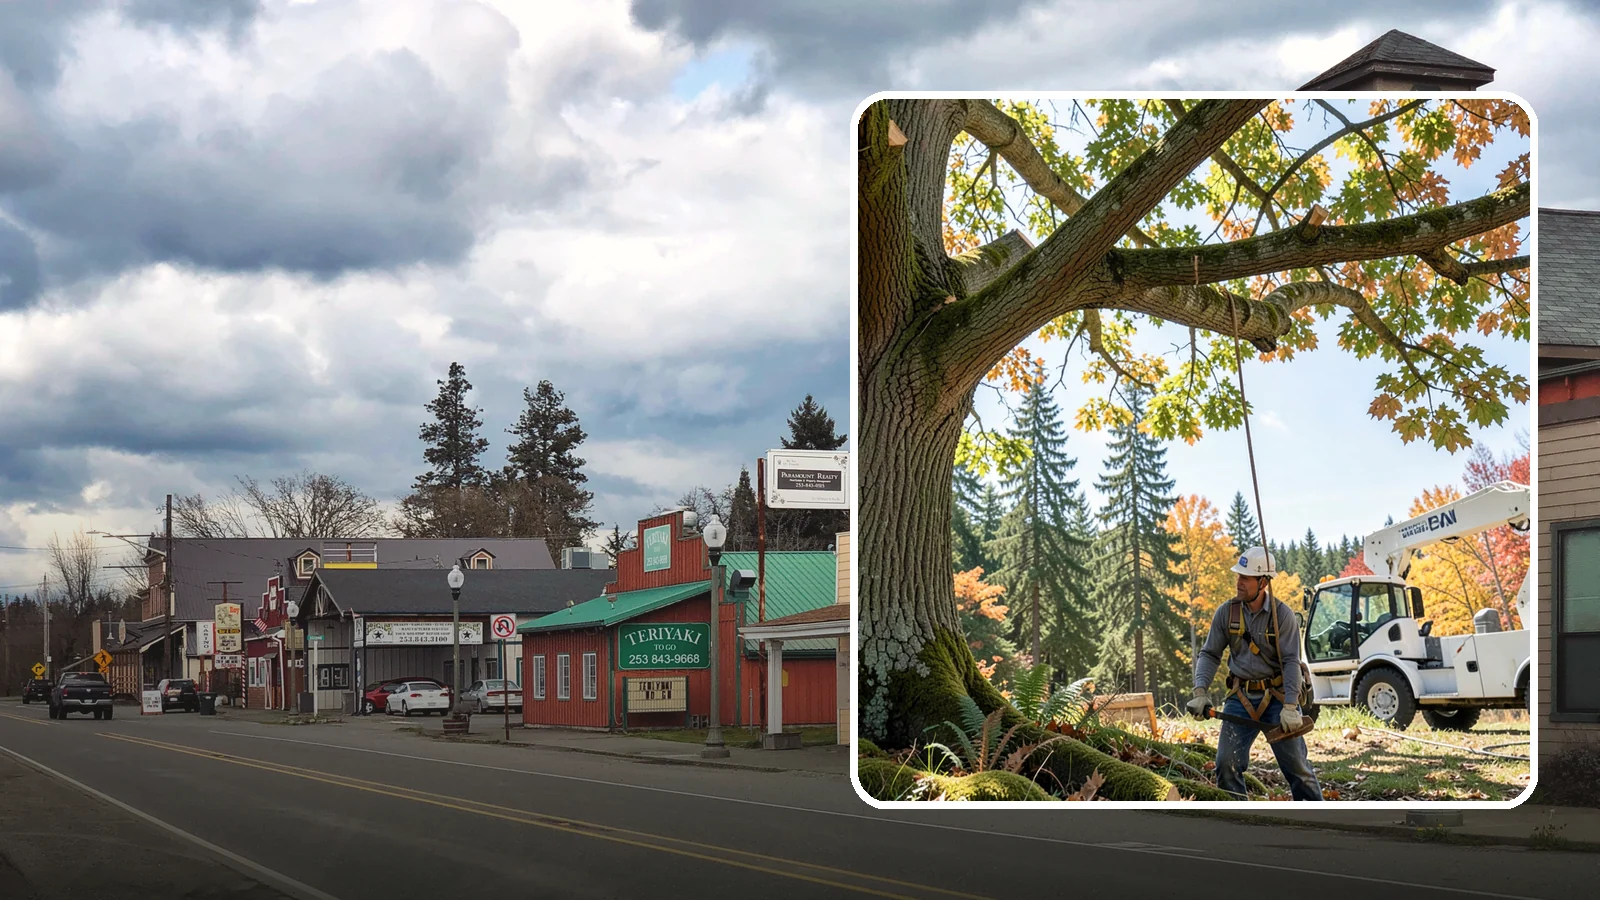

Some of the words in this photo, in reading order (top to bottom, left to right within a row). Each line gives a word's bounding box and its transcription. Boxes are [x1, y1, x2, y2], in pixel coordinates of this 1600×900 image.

[781, 471, 815, 479] PARAMOUNT
[817, 472, 839, 480] REALTY
[625, 627, 702, 646] TERIYAKI
[628, 654, 648, 665] 253
[651, 653, 700, 664] 843-9668
